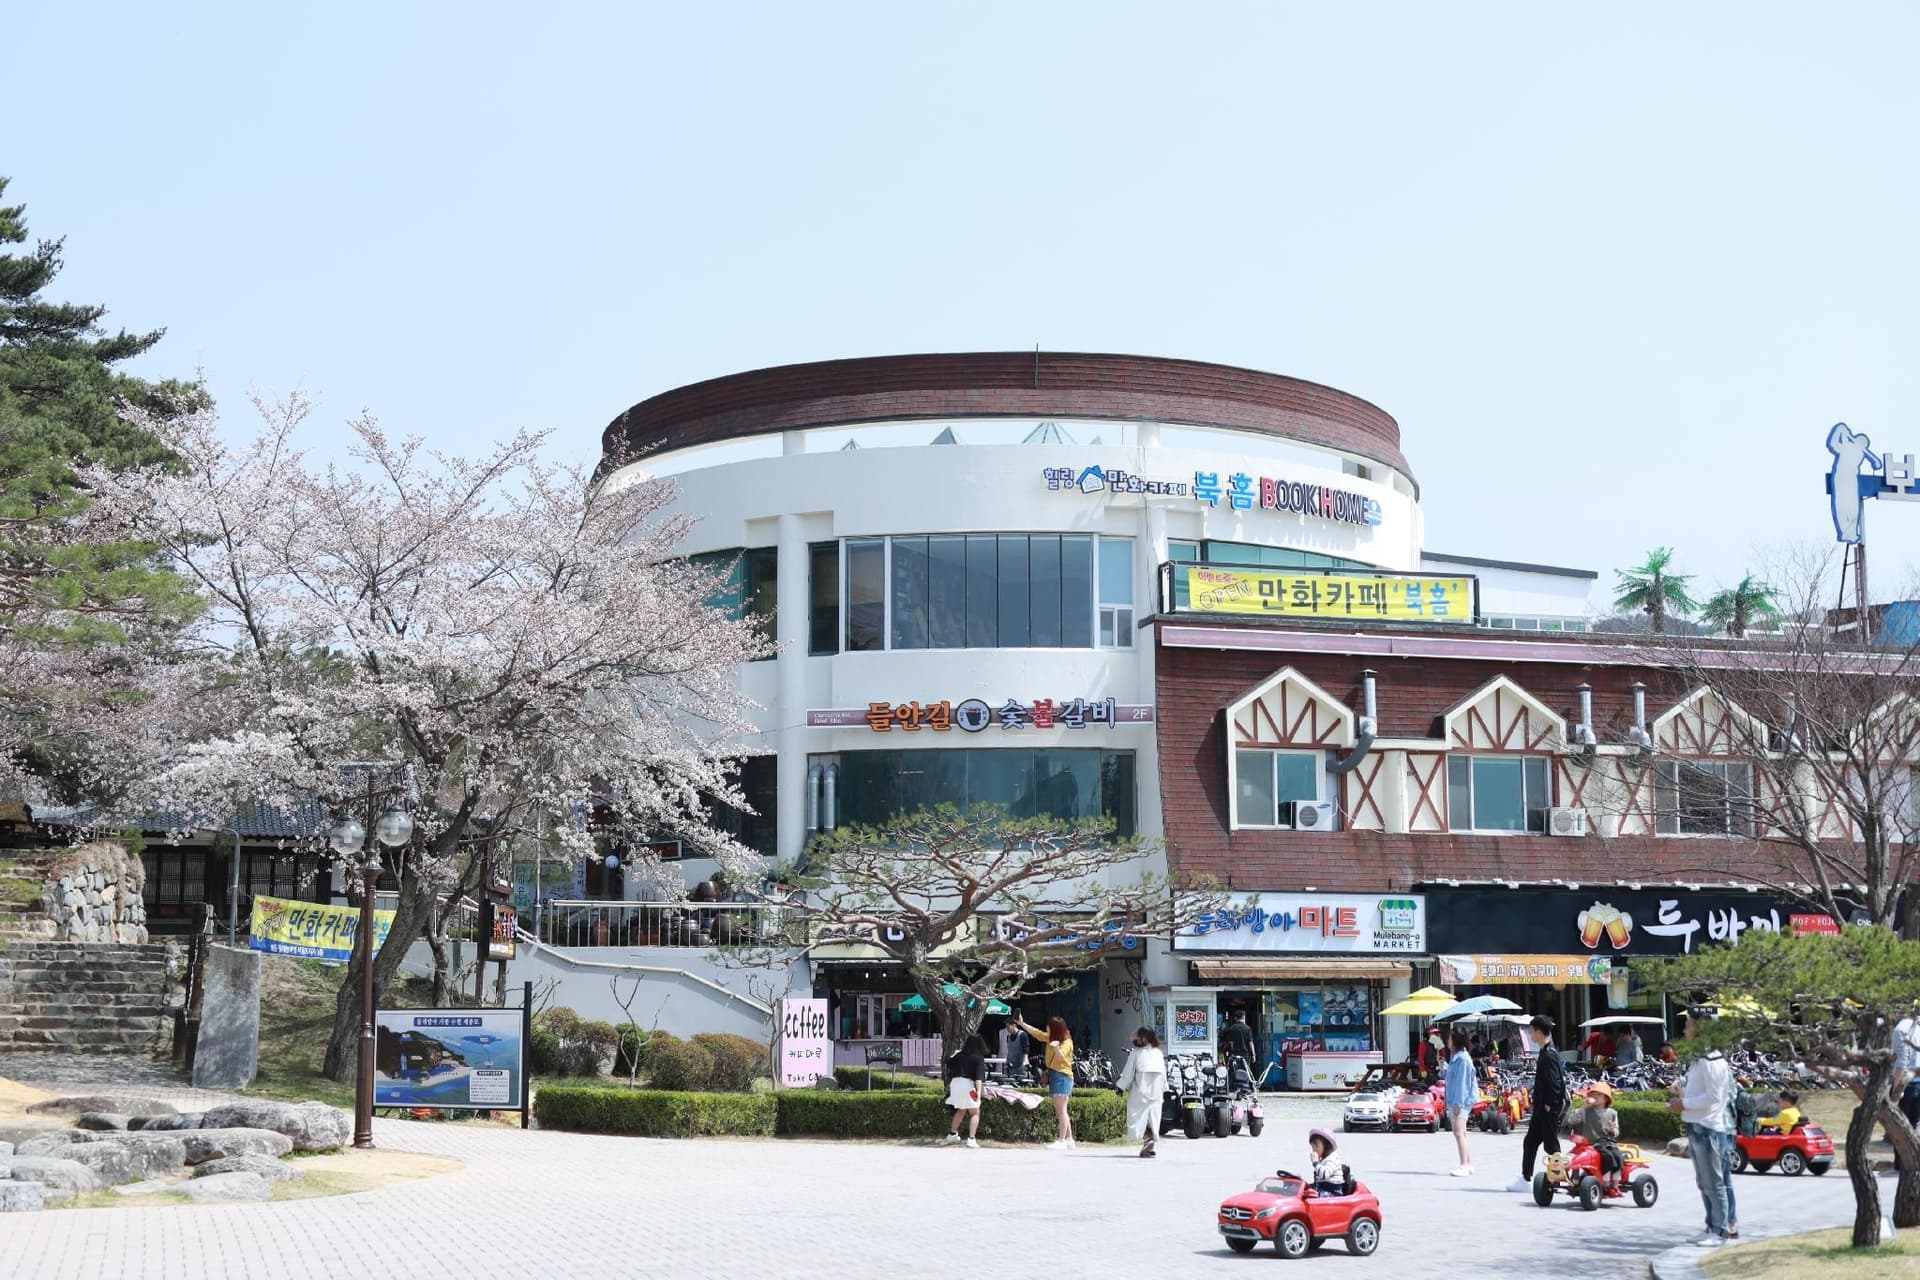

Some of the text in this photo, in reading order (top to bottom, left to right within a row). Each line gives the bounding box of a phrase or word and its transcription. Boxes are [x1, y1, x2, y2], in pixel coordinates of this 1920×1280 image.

[1043, 467, 1075, 490] 힐링
[1106, 469, 1187, 496] 만화카페
[1192, 470, 1256, 510] 북홈
[1200, 579, 1253, 609] OPEN
[864, 700, 953, 733] 들안길
[997, 697, 1117, 729] 숯불갈비
[1132, 708, 1149, 720] 2F
[1298, 905, 1361, 938] 마트
[1373, 941, 1421, 949] MARKET
[785, 1005, 825, 1039] coffee
[787, 1073, 805, 1082] Take
